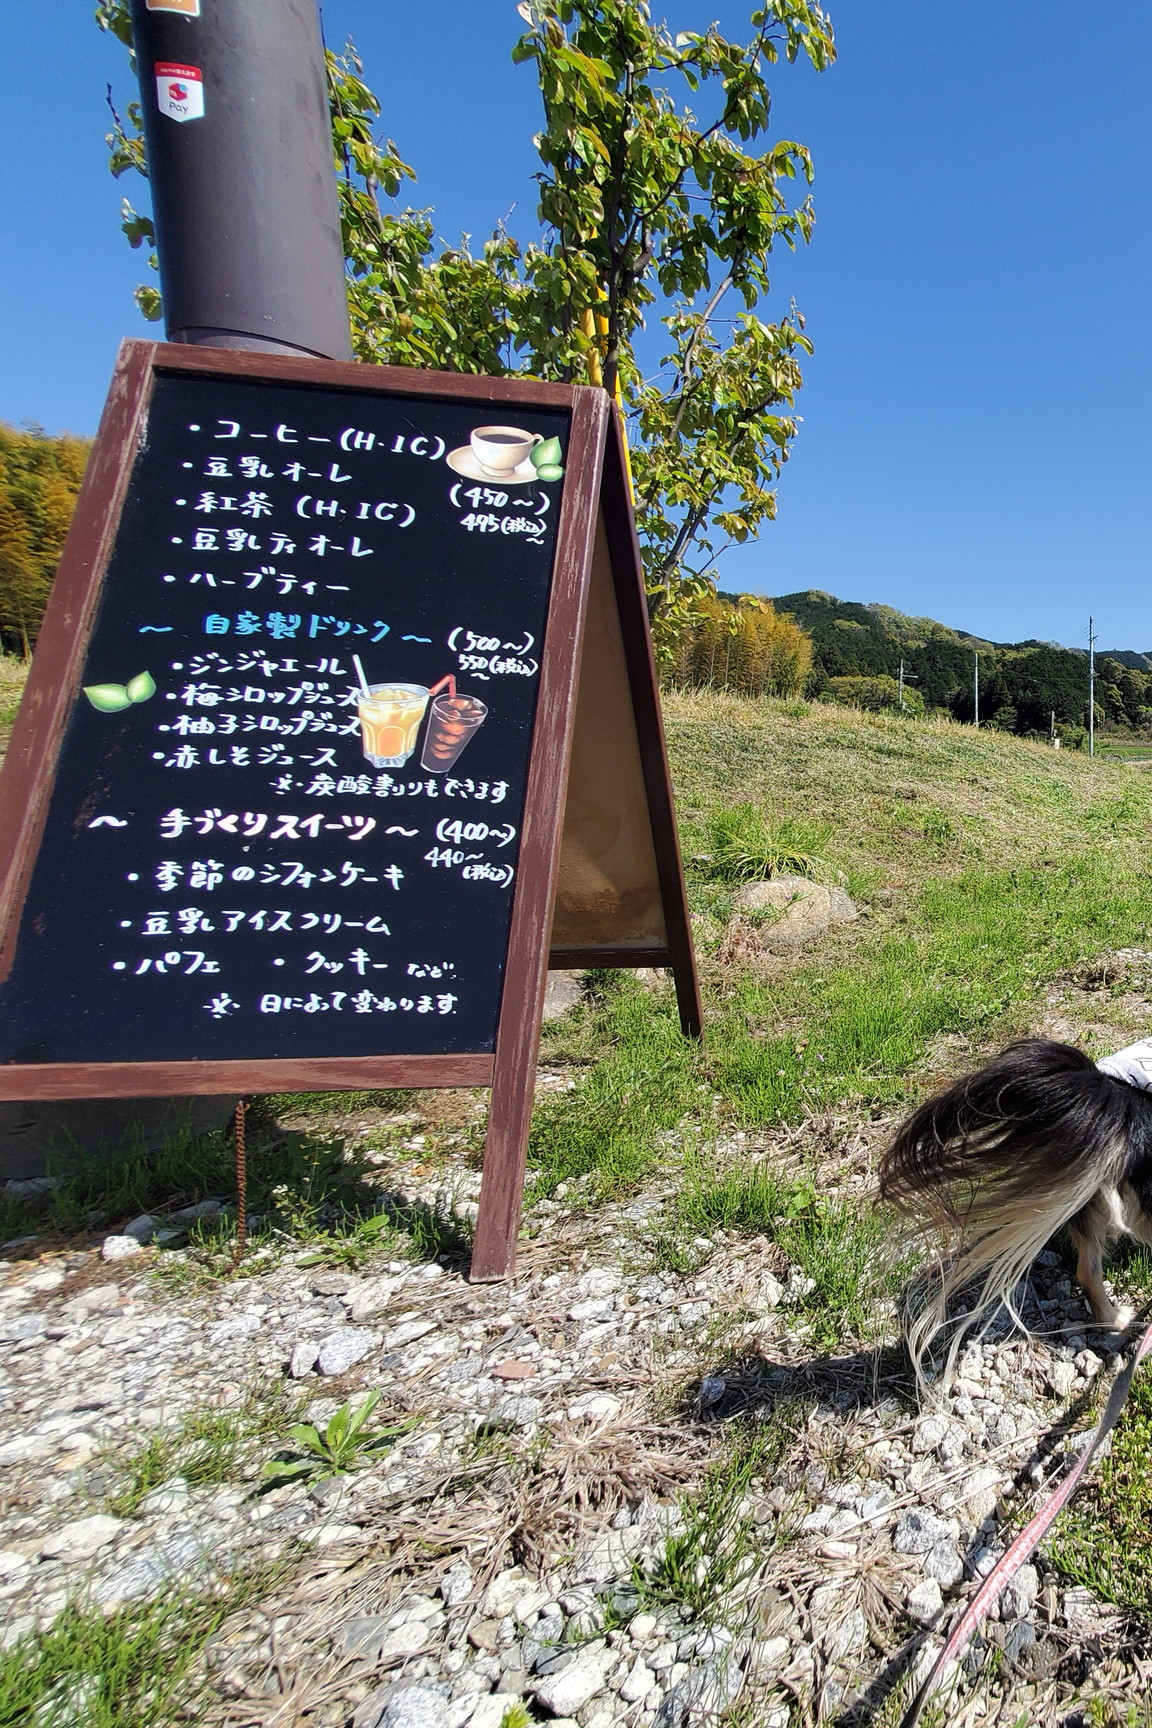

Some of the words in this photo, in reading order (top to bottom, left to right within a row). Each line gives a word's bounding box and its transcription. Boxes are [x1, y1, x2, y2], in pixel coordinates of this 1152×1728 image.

[169, 101, 189, 115] Pay
[203, 456, 353, 482] 豆乳オーレ
[194, 490, 274, 519] 紅茶
[191, 527, 375, 557] 豆乳ティオーレ
[188, 566, 350, 595] ハーブティー
[205, 611, 391, 643] 自家製ドリンク
[189, 649, 348, 677] ジンジャエール
[181, 681, 359, 707] 梅シロップジュース
[172, 710, 362, 737] 柚子シロップジュース
[164, 743, 339, 769] 赤しそジュース
[160, 808, 377, 841] 手づくりスイーツ
[155, 859, 405, 891] 季節のシフォンケーキ
[141, 907, 392, 937] 豆乳アイスクリーム
[134, 951, 221, 975] パフェ
[304, 947, 389, 976] クッキー
